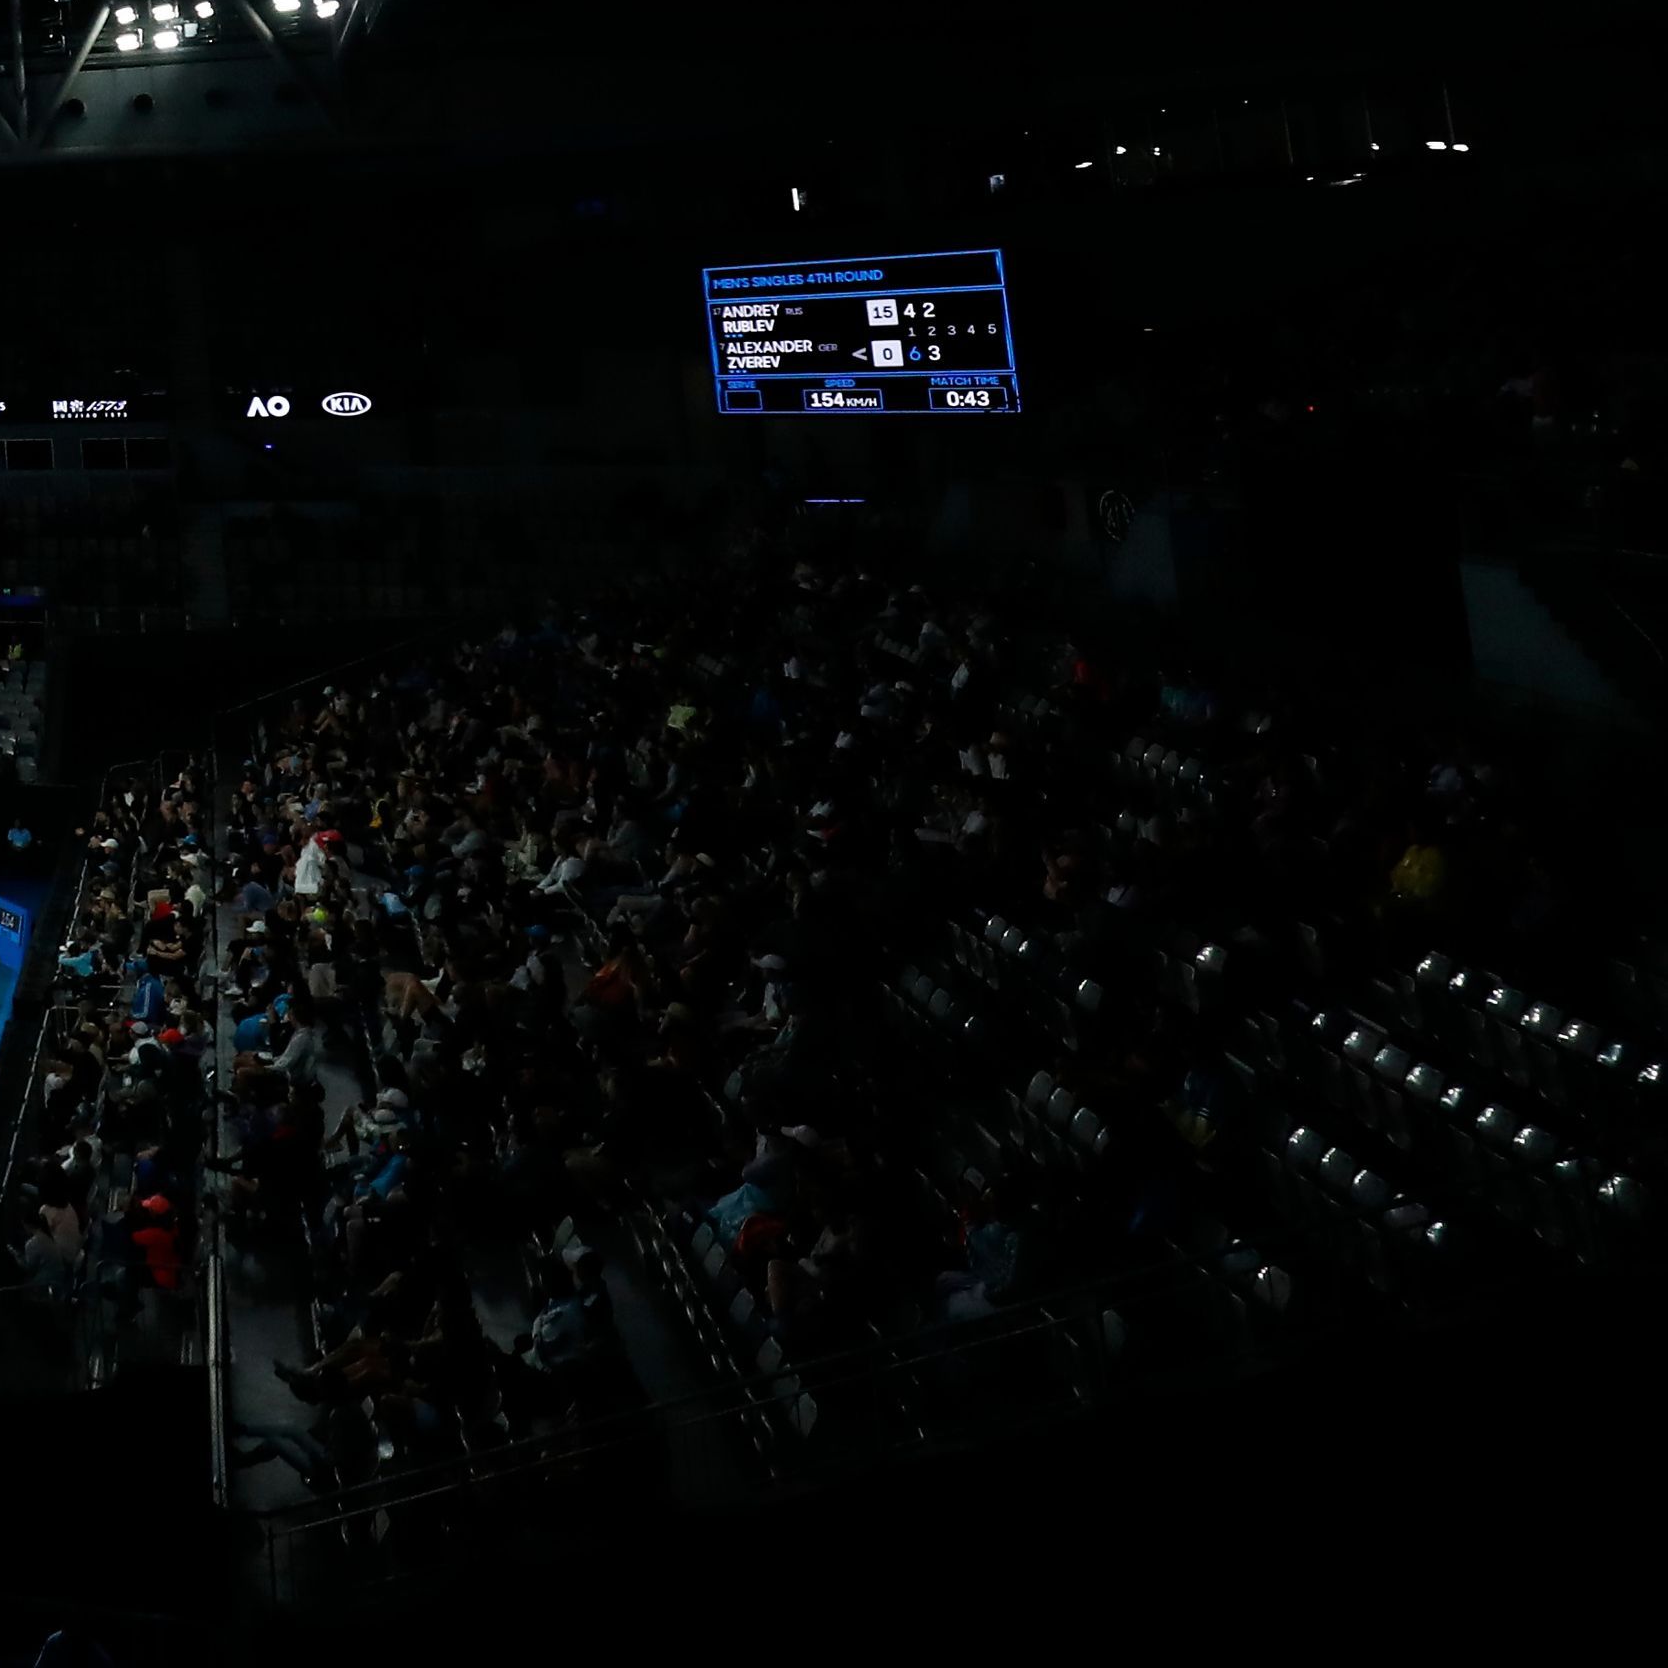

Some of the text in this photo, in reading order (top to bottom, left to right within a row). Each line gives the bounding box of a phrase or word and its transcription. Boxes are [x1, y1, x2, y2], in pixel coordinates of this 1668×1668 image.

[713, 269, 884, 289] MEN'S SINGLES 4TH ROUND
[722, 304, 780, 318] ANDREY
[785, 307, 803, 316] RUS
[872, 302, 936, 319] 15 4 2
[723, 319, 775, 333] RUBLEV
[908, 323, 997, 337] 1 2 3 4 5
[726, 339, 813, 355] ALEXANDER
[882, 345, 942, 361] 0 6 3
[727, 355, 781, 369] ZVEREV
[727, 380, 756, 389] SERVE
[824, 379, 856, 388] SPEED
[930, 376, 1000, 386] MATCH TIME
[810, 392, 878, 408] 154 KM/H
[946, 390, 990, 407] 0:43
[246, 395, 291, 419] AO
